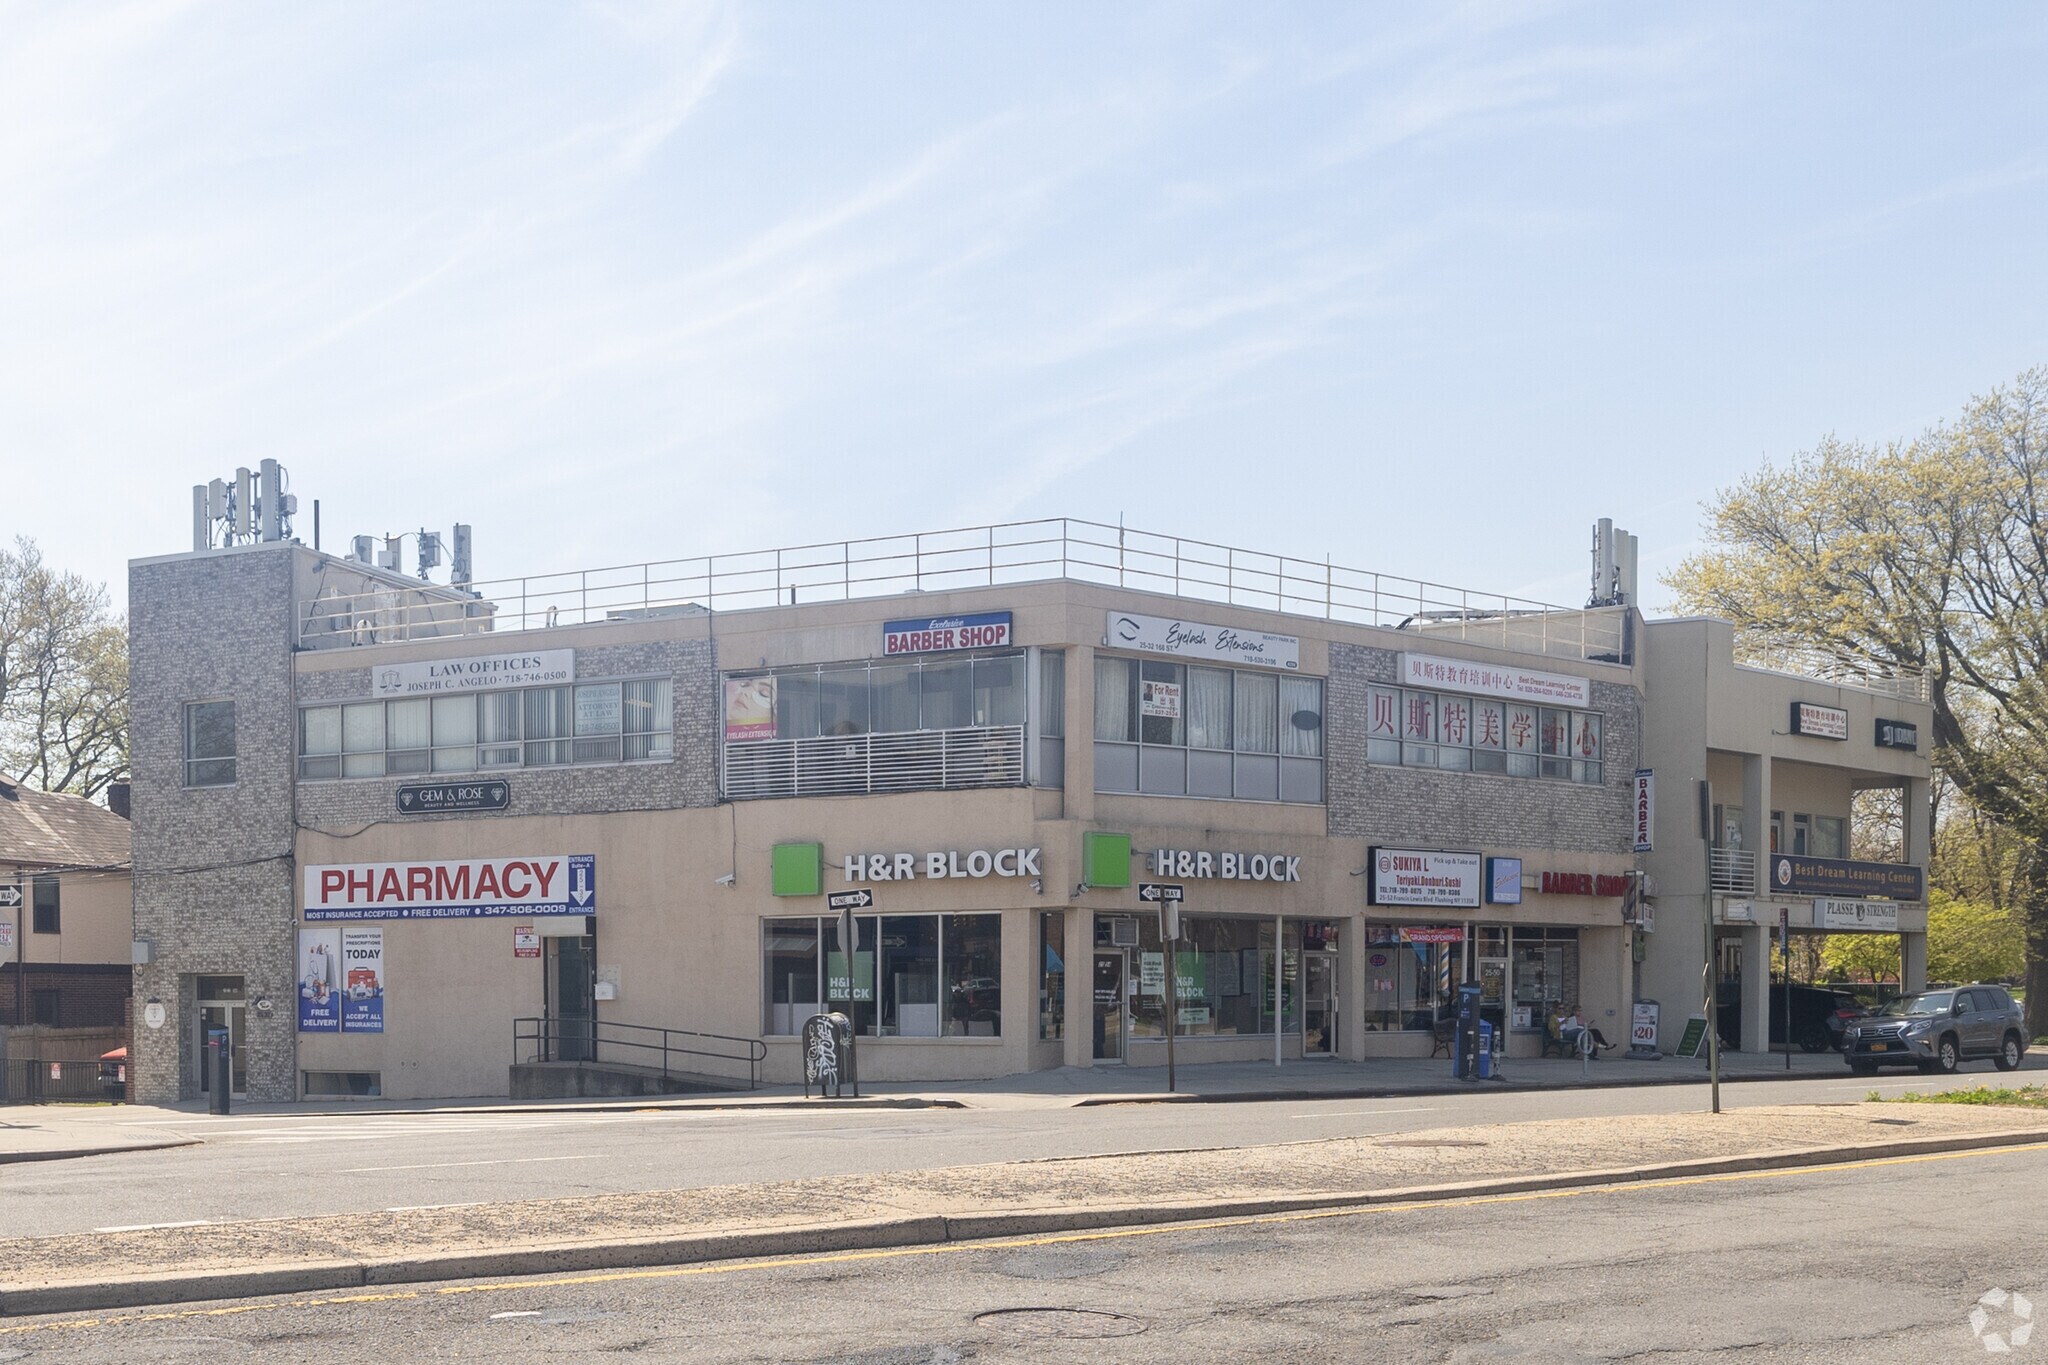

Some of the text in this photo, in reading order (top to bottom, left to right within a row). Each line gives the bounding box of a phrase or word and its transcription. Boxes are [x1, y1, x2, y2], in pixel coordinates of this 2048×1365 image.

[929, 619, 964, 629] Exclusive
[888, 625, 1006, 653] BARBER SHOP
[1166, 623, 1264, 652] Eyelash Extensions
[430, 657, 541, 677] LAW OFFICES
[407, 671, 567, 692] JOSEPH C. ANGELO 718-746-0500
[1412, 660, 1513, 690] 贝斯特教育培训中心
[1154, 684, 1179, 696] For Rent
[1519, 676, 1581, 691] Best Dream Learning Center
[579, 702, 618, 711] ATTORNEY
[1372, 692, 1597, 756] 贝斯特美学中心
[419, 787, 484, 802] GEM & ROSE
[1638, 778, 1648, 843] BARBER
[844, 848, 1041, 882] H&R BLOCK
[1158, 849, 1301, 882] H&R BLOCK
[1393, 856, 1422, 871] SUKIYA
[1795, 863, 1915, 883] Best Dream Learning Center
[321, 861, 560, 903] PHARMACY
[1542, 871, 1593, 895] BARBER
[1596, 874, 1628, 897] SHOP
[0, 891, 16, 900] WAY
[834, 894, 865, 905] ONE WAY
[1146, 889, 1160, 897] ONE
[326, 910, 362, 918] INSURANCE
[411, 909, 431, 917] FREE
[433, 907, 470, 916] DELIVERY
[485, 905, 566, 914] 347-506-0009
[1827, 902, 1896, 917] PLASSE STRENGTH
[346, 949, 381, 959] TODAY
[1176, 977, 1194, 986] H&R
[830, 989, 869, 999] BLOCK
[1176, 988, 1204, 997] BLOCK
[303, 1019, 337, 1027] DELIVERY
[1634, 1026, 1654, 1040] $20
